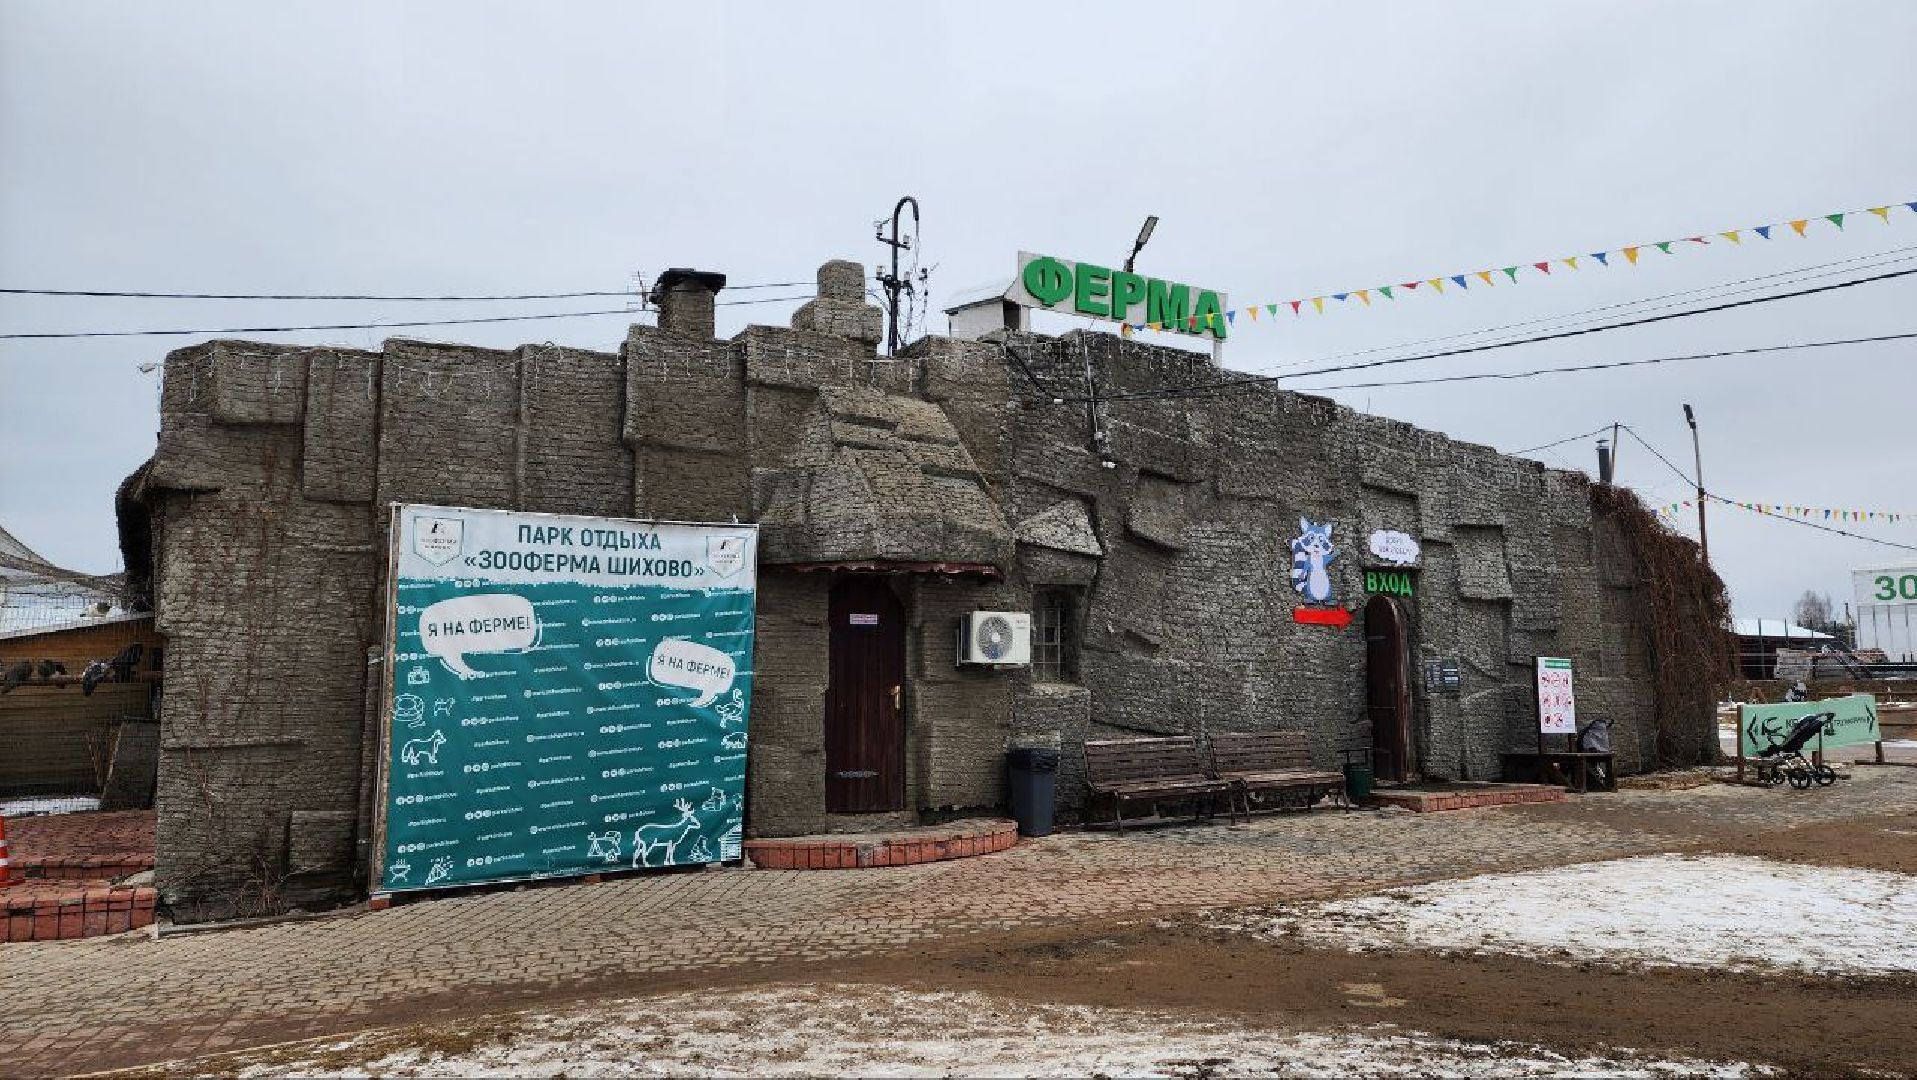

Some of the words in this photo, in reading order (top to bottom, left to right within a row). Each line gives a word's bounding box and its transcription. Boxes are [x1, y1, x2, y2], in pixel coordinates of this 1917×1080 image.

[1023, 256, 1227, 338] ФЕРМА
[518, 524, 573, 546] ПАРК
[580, 527, 662, 551] ОТДЫХА
[464, 549, 601, 574] «ЗООФЕРМА
[607, 556, 705, 577] ШИХОВО»
[1367, 571, 1413, 597] ВХОД
[428, 622, 438, 637] Я
[443, 620, 465, 636] НА
[469, 616, 531, 634] ФЕРМЕ!
[657, 653, 665, 666] Я
[668, 656, 683, 670] НА
[687, 659, 731, 679] ФЕРМЕ!
